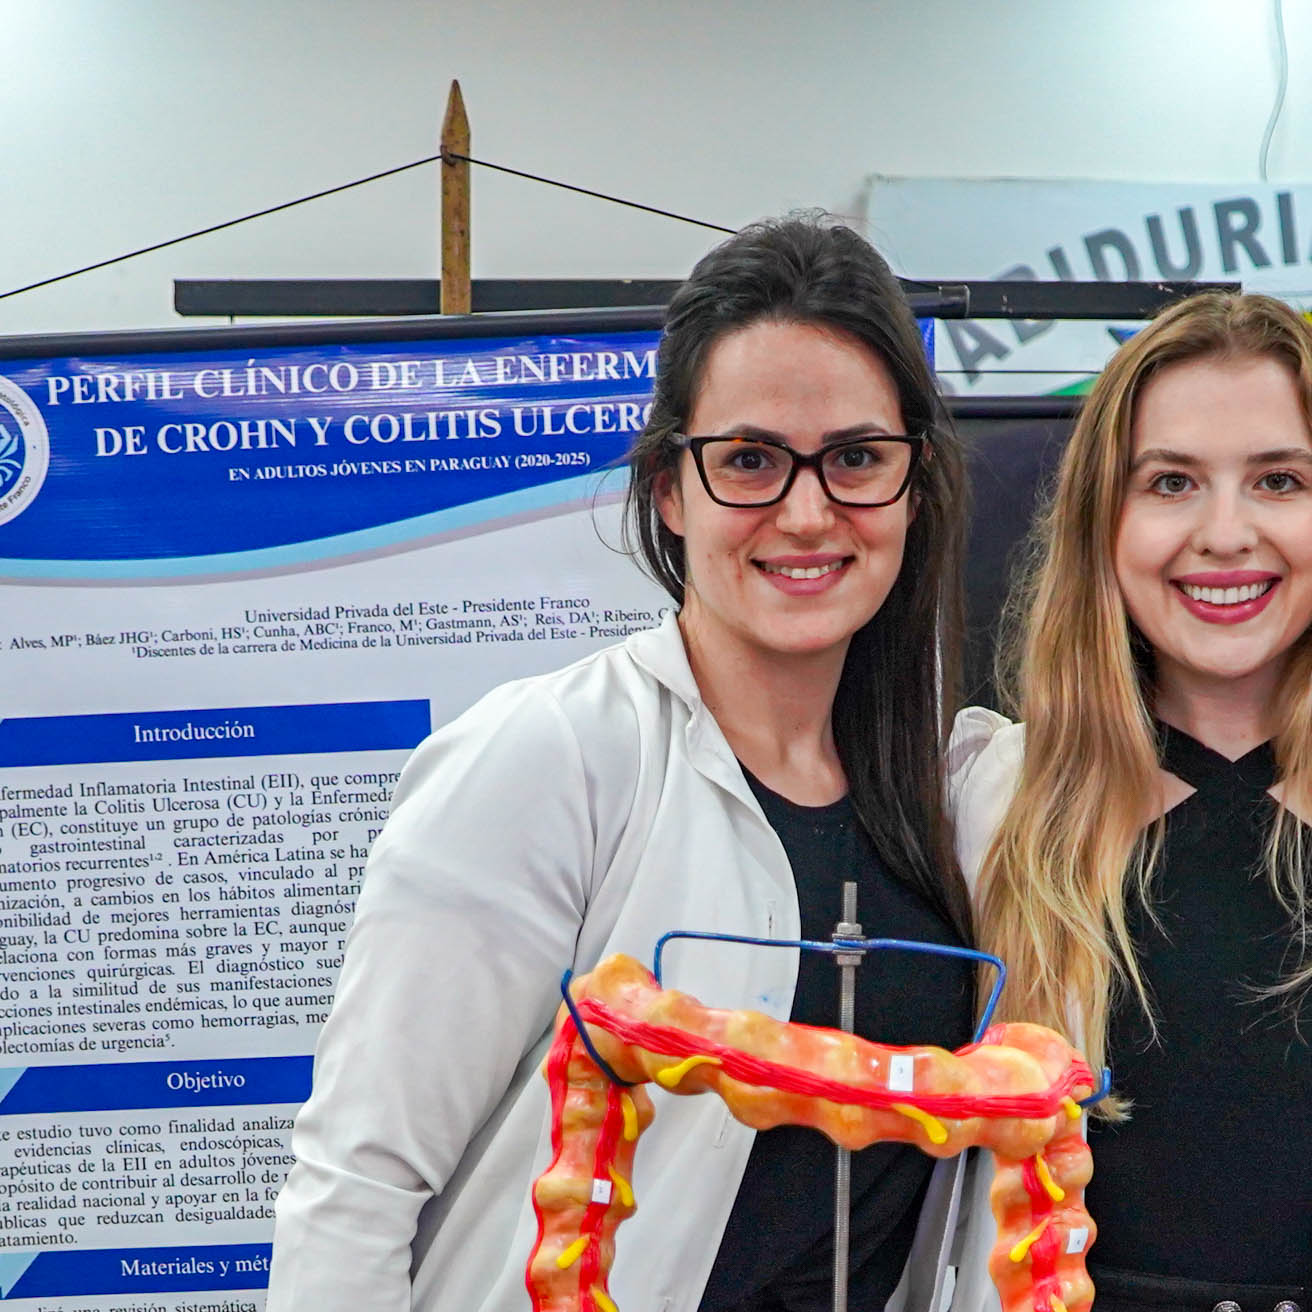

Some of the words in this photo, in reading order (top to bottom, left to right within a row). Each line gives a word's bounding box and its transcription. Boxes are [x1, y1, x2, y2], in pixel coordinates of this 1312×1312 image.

[47, 371, 183, 405] PERFIL
[193, 358, 358, 398] CLÍNICO
[371, 360, 424, 390] DE
[435, 358, 482, 386] LA
[93, 426, 148, 456] DE
[156, 418, 296, 453] CROHN
[306, 416, 333, 446] Y
[343, 408, 502, 445] COLITIS
[229, 467, 250, 481] EN
[254, 464, 326, 480] ADULTOS
[330, 459, 401, 476] JÓVENES
[406, 459, 425, 472] EN
[430, 455, 511, 471] PARAGUAY
[515, 452, 590, 470] (2020-2025)
[8, 476, 31, 504] Franco
[245, 606, 330, 624] Universidad
[335, 604, 387, 620] Privada
[392, 603, 414, 617] del
[418, 602, 448, 616] Este
[462, 598, 535, 614] Presidente
[539, 597, 591, 610] Franco
[9, 637, 47, 651] Alves,
[85, 633, 115, 646] Báez
[161, 628, 218, 643] Carboni,
[253, 625, 300, 639] Cunha,
[347, 621, 396, 635] Franco,
[426, 616, 496, 631] Gastmann,
[535, 612, 566, 626] Reis,
[603, 609, 655, 623] Ribeiro,
[199, 644, 215, 655] de
[218, 643, 229, 654] la
[232, 643, 277, 653] carrera
[281, 641, 296, 652] de
[299, 636, 358, 650] Medicina
[362, 635, 377, 647] de
[380, 635, 392, 646] la
[396, 631, 472, 646] Universidad
[476, 629, 525, 643] Privada
[528, 627, 547, 640] del
[550, 627, 578, 639] Este
[134, 721, 255, 743] Introducción
[80, 779, 177, 798] Inflamatoria
[184, 774, 255, 793] Intestinal
[262, 772, 305, 792] (EII),
[310, 774, 338, 790] que
[74, 801, 89, 816] la
[95, 798, 145, 815] Colitis
[152, 795, 220, 812] Ulcerosa
[227, 792, 268, 811] (CU)
[275, 796, 283, 810] y
[289, 791, 304, 806] la
[166, 1072, 245, 1091] Objetivo
[17, 1126, 72, 1140] estudio
[78, 1125, 112, 1138] tuvo
[119, 1124, 161, 1136] como
[168, 1118, 235, 1135] finalidad
[242, 1117, 295, 1132] analiza
[121, 1258, 214, 1277] Materiales
[219, 1262, 230, 1277] y
